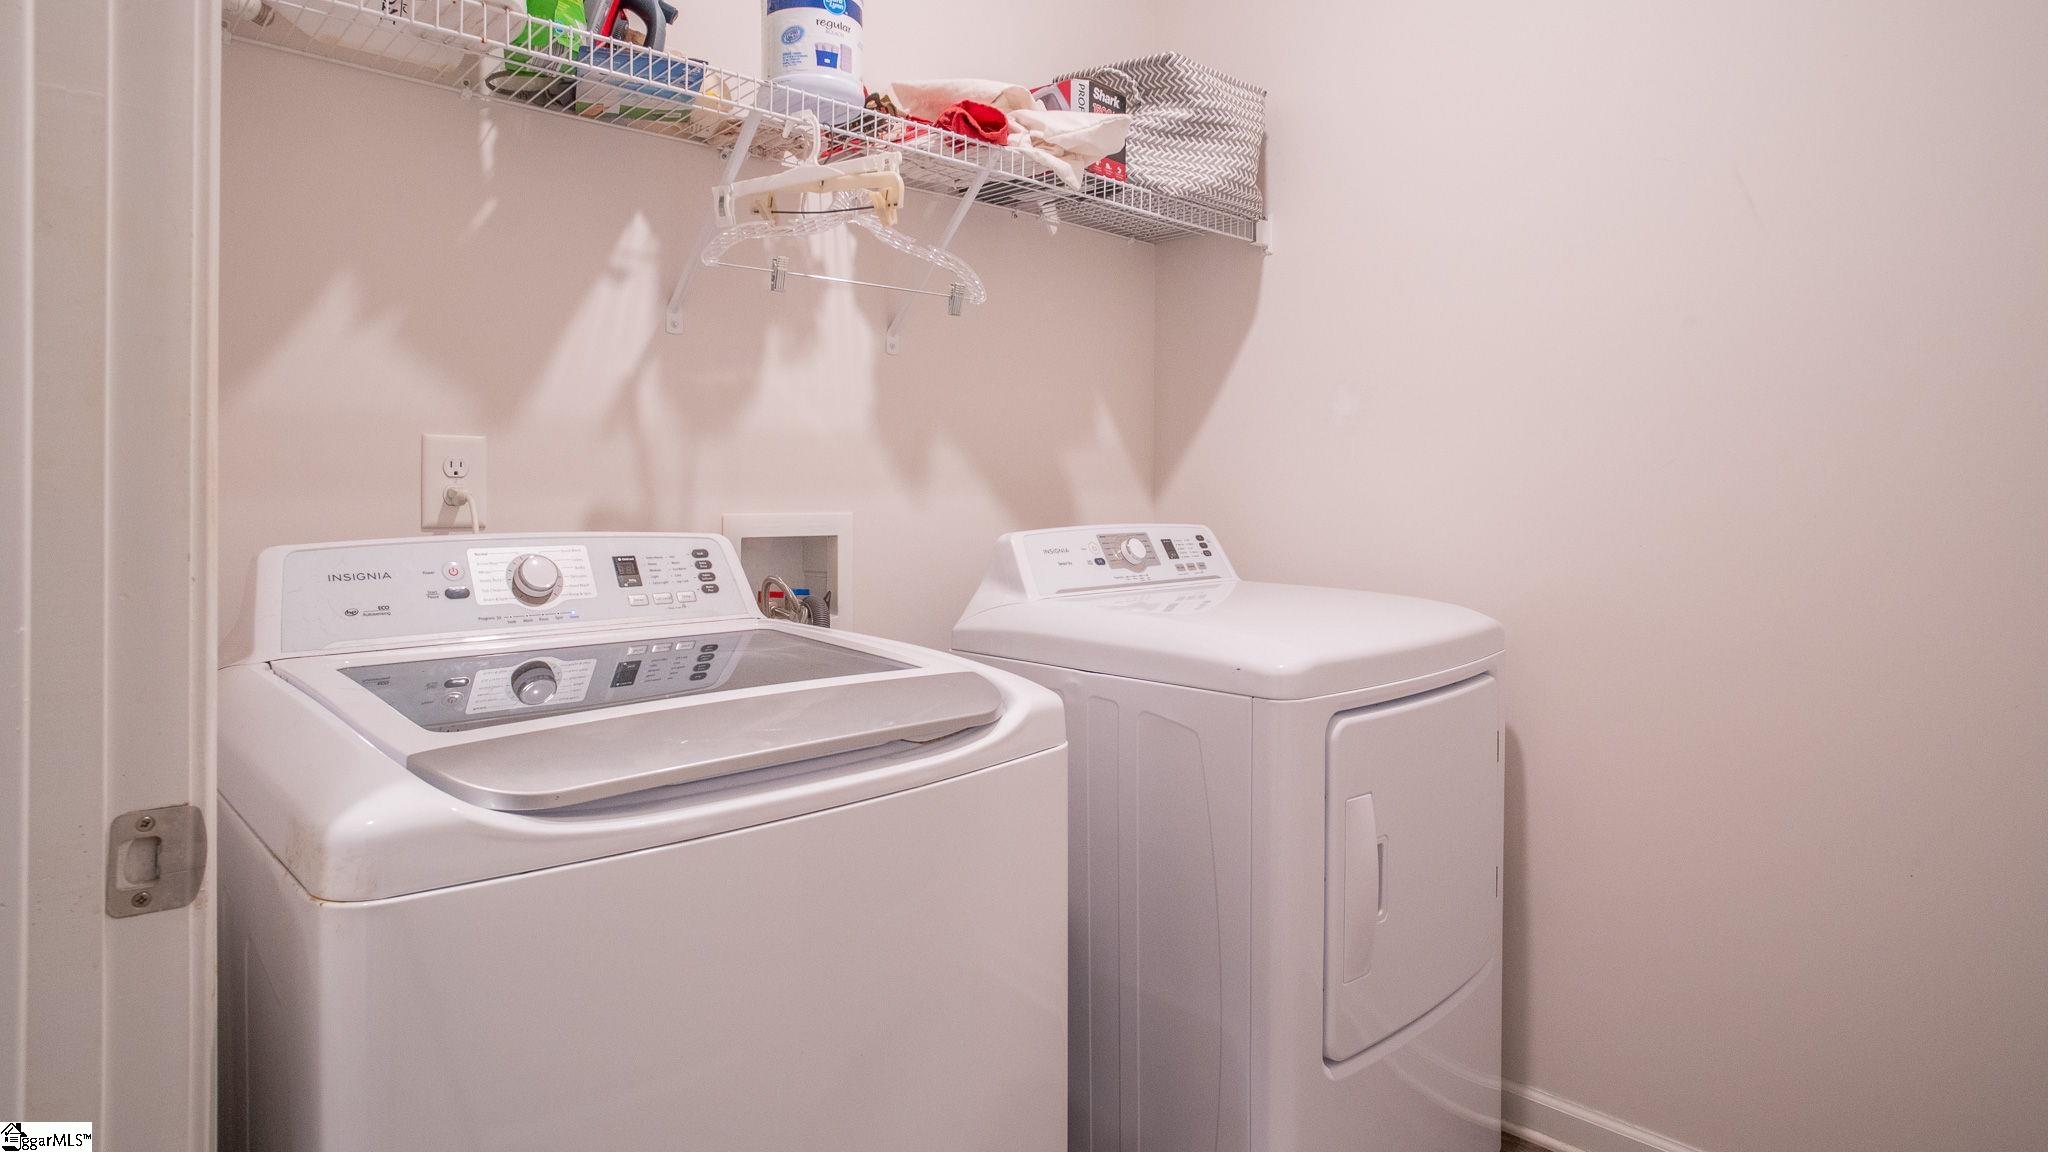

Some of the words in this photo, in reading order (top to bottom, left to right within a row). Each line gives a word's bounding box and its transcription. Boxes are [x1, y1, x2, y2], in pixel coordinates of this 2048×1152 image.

[816, 19, 851, 32] regular
[1092, 86, 1121, 109] Shark
[327, 571, 392, 582] INSIGNIA
